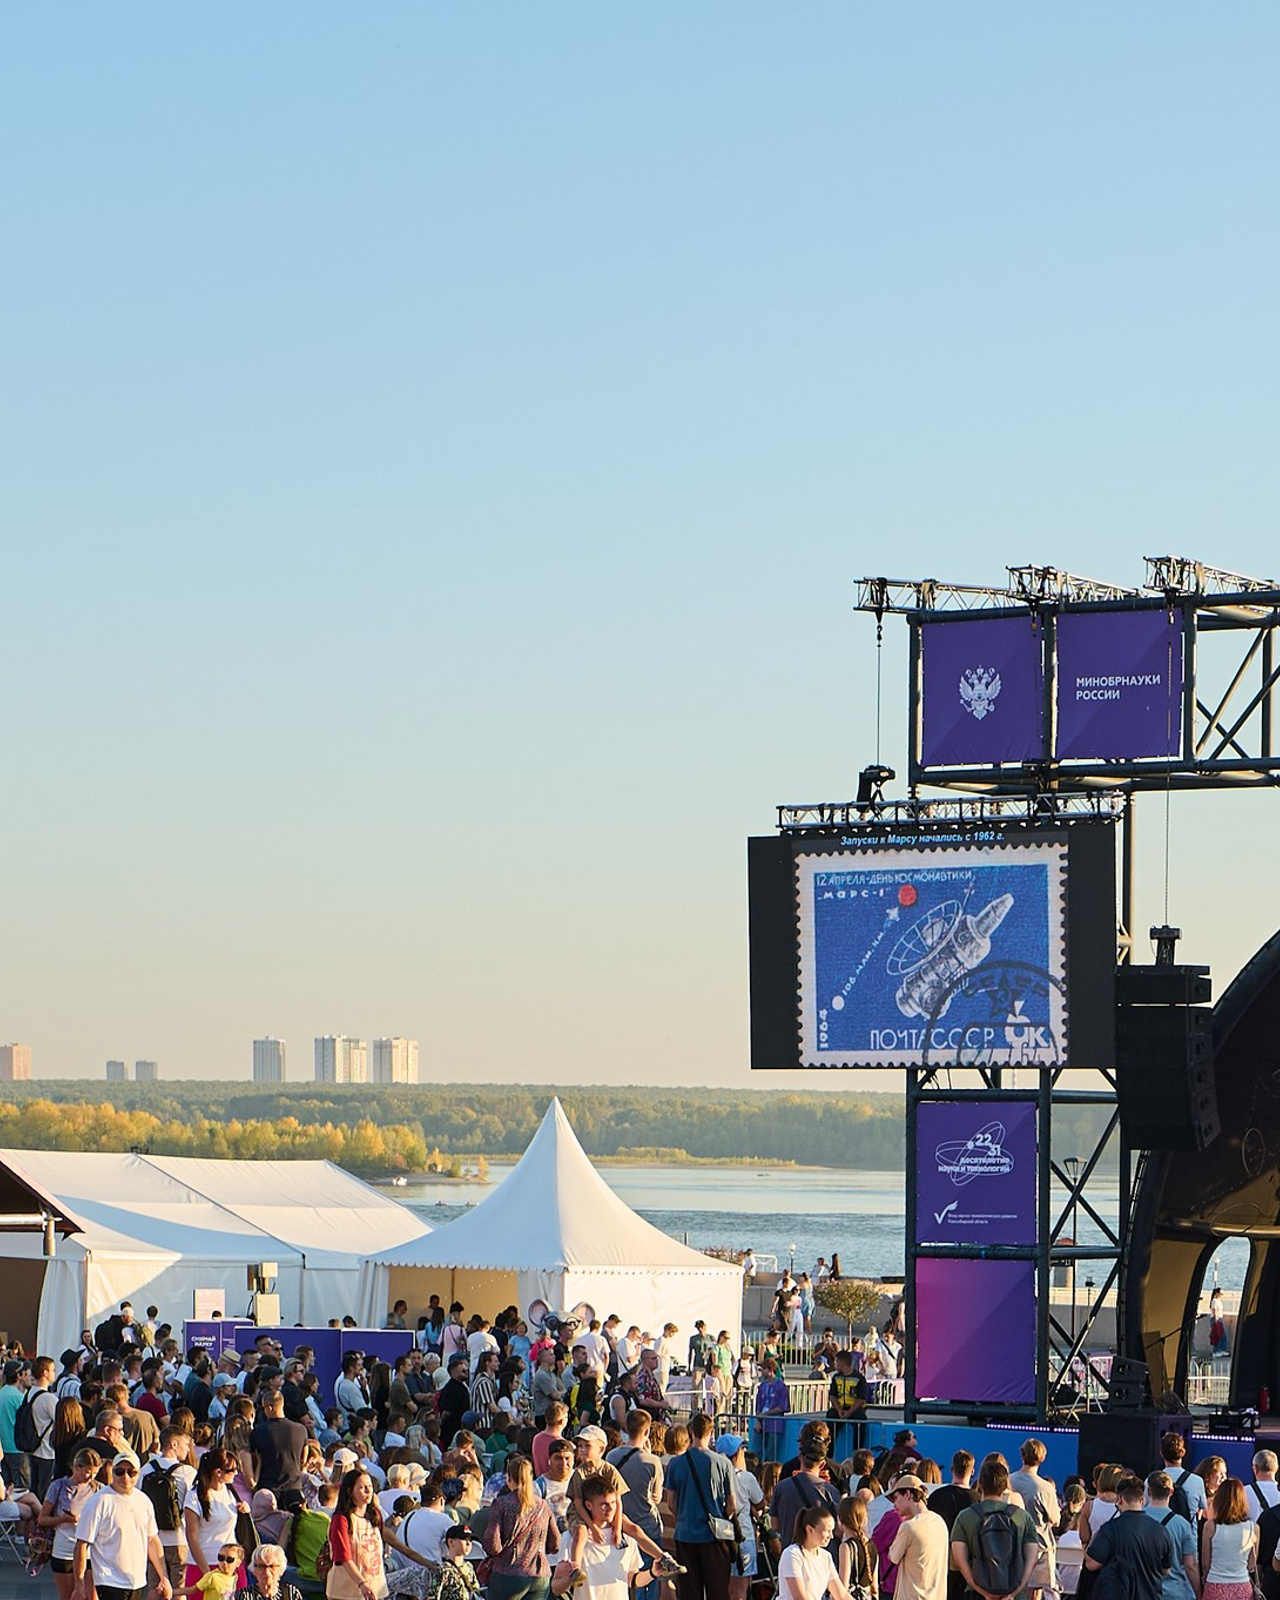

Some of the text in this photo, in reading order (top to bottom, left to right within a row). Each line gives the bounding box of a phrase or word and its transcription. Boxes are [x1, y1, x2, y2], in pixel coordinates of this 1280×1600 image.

[1076, 674, 1161, 687] МИНОБРНАУКИ
[1076, 689, 1120, 700] РОССИИ
[840, 835, 878, 847] Запуски
[880, 837, 886, 845] к
[887, 833, 918, 846] Марсу
[919, 833, 963, 844] начались
[965, 834, 972, 842] с
[973, 830, 995, 842] 1962
[816, 875, 826, 886] 12
[930, 1027, 995, 1050] СССР
[975, 1133, 992, 1147] 22
[987, 1145, 1001, 1157] 31
